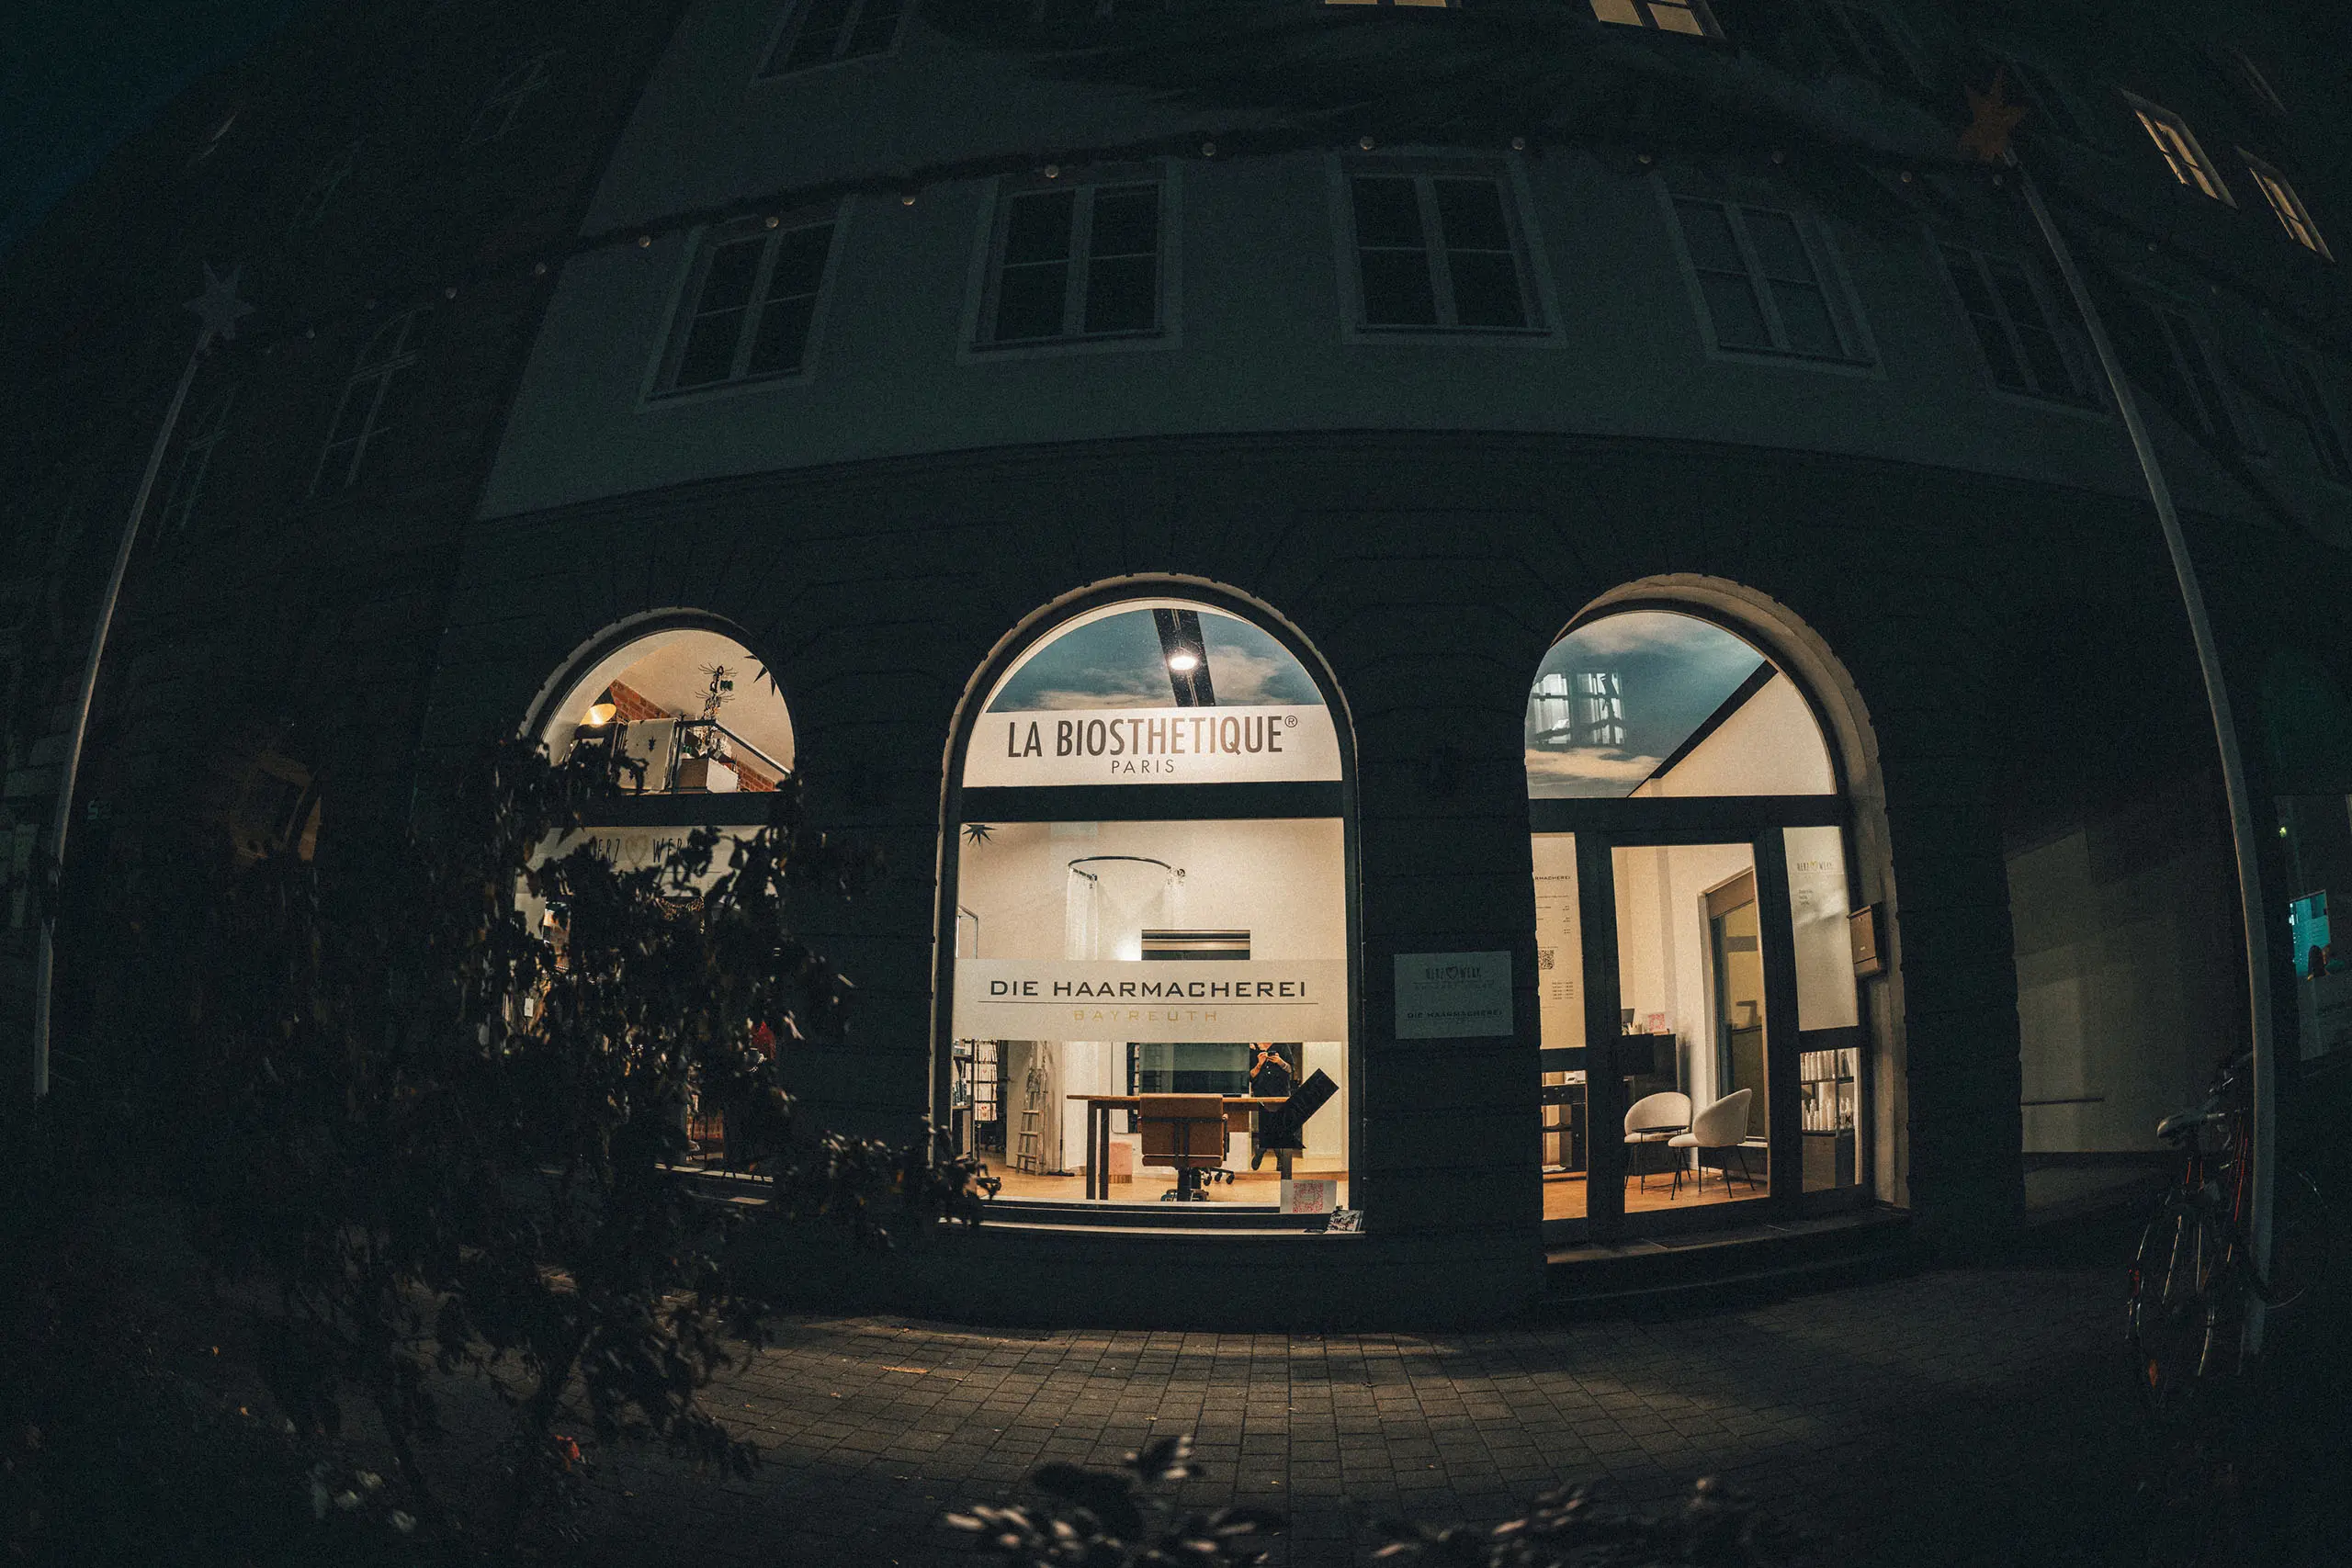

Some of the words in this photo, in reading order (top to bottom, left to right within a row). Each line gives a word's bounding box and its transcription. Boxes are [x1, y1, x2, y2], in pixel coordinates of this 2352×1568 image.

[1008, 721, 1043, 758] LA
[1111, 759, 1175, 774] PARIS
[990, 980, 1039, 997] DIE
[1053, 980, 1306, 998] HAARMACHEREI
[1072, 1010, 1218, 1022] BAYREUTH
